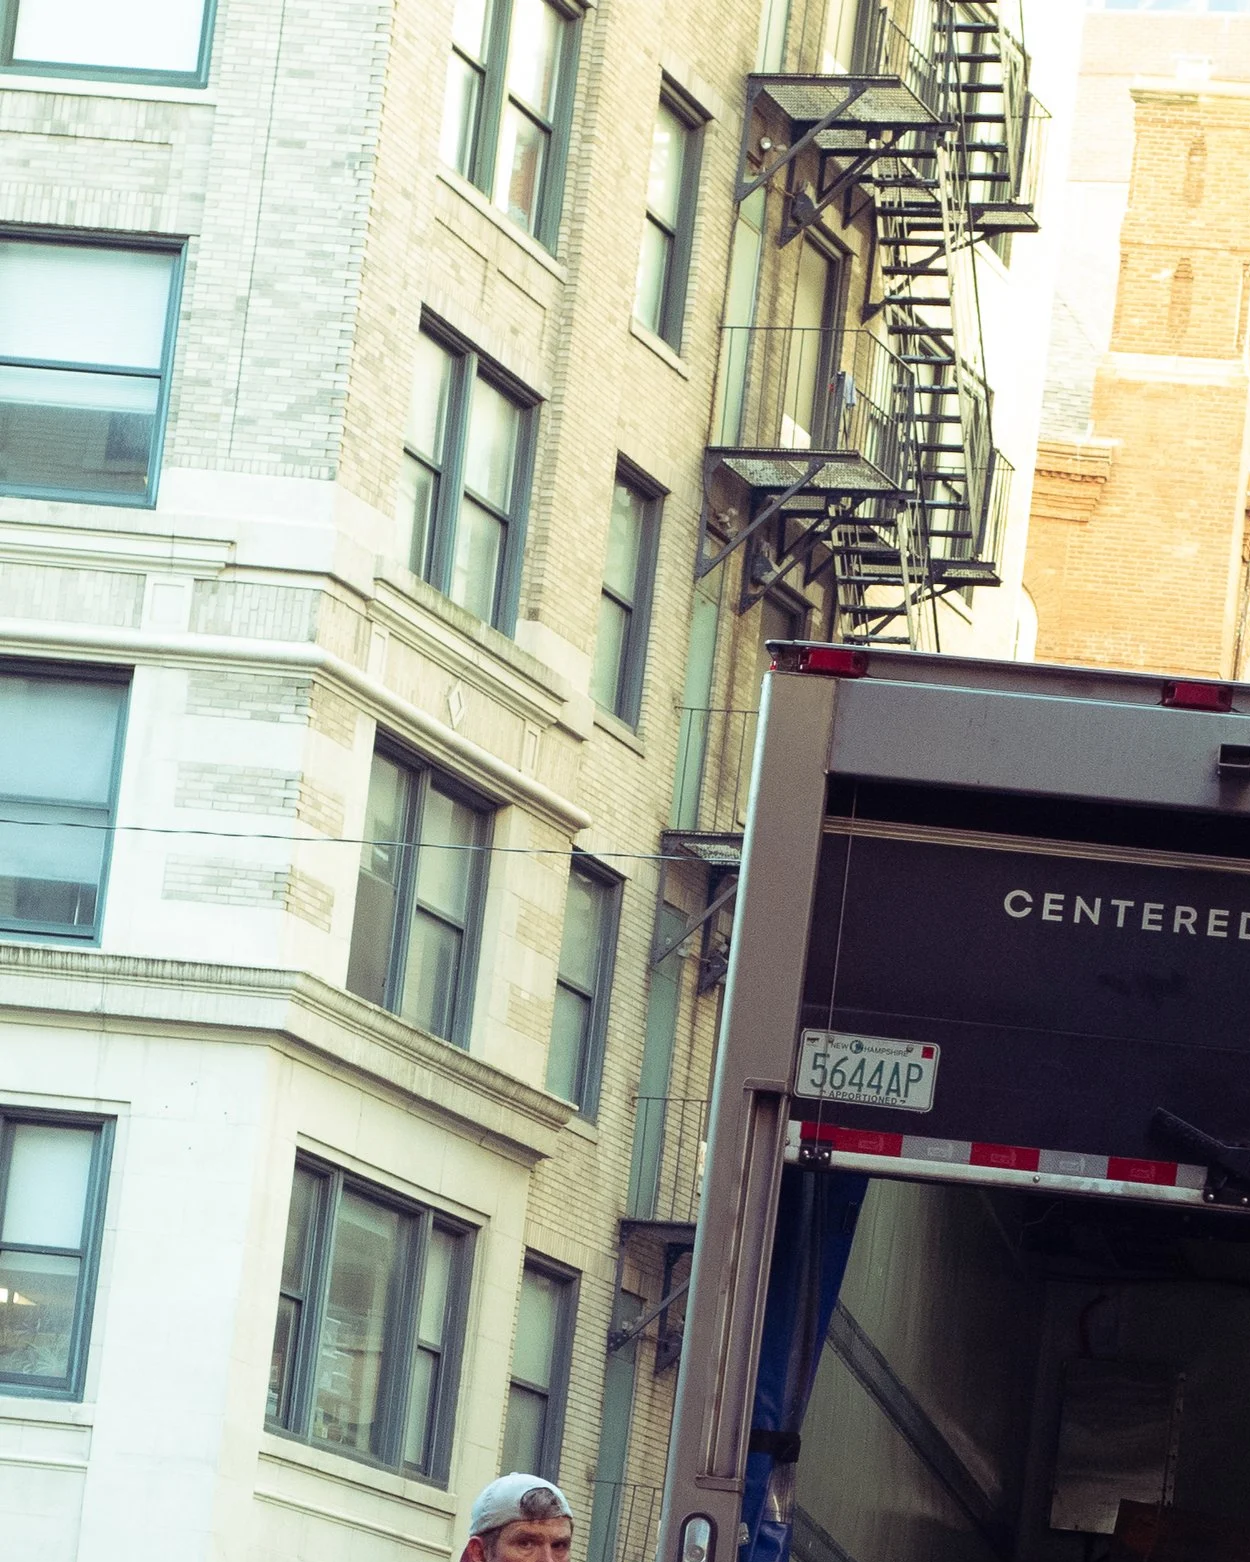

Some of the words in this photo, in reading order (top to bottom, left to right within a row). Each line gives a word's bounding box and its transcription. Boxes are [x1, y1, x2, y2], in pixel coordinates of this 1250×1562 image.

[830, 1041, 849, 1050] NEW
[863, 1045, 908, 1058] HAMPSHIRE
[810, 1052, 924, 1098] 5644AP
[828, 1090, 898, 1105] APPORTIONED
